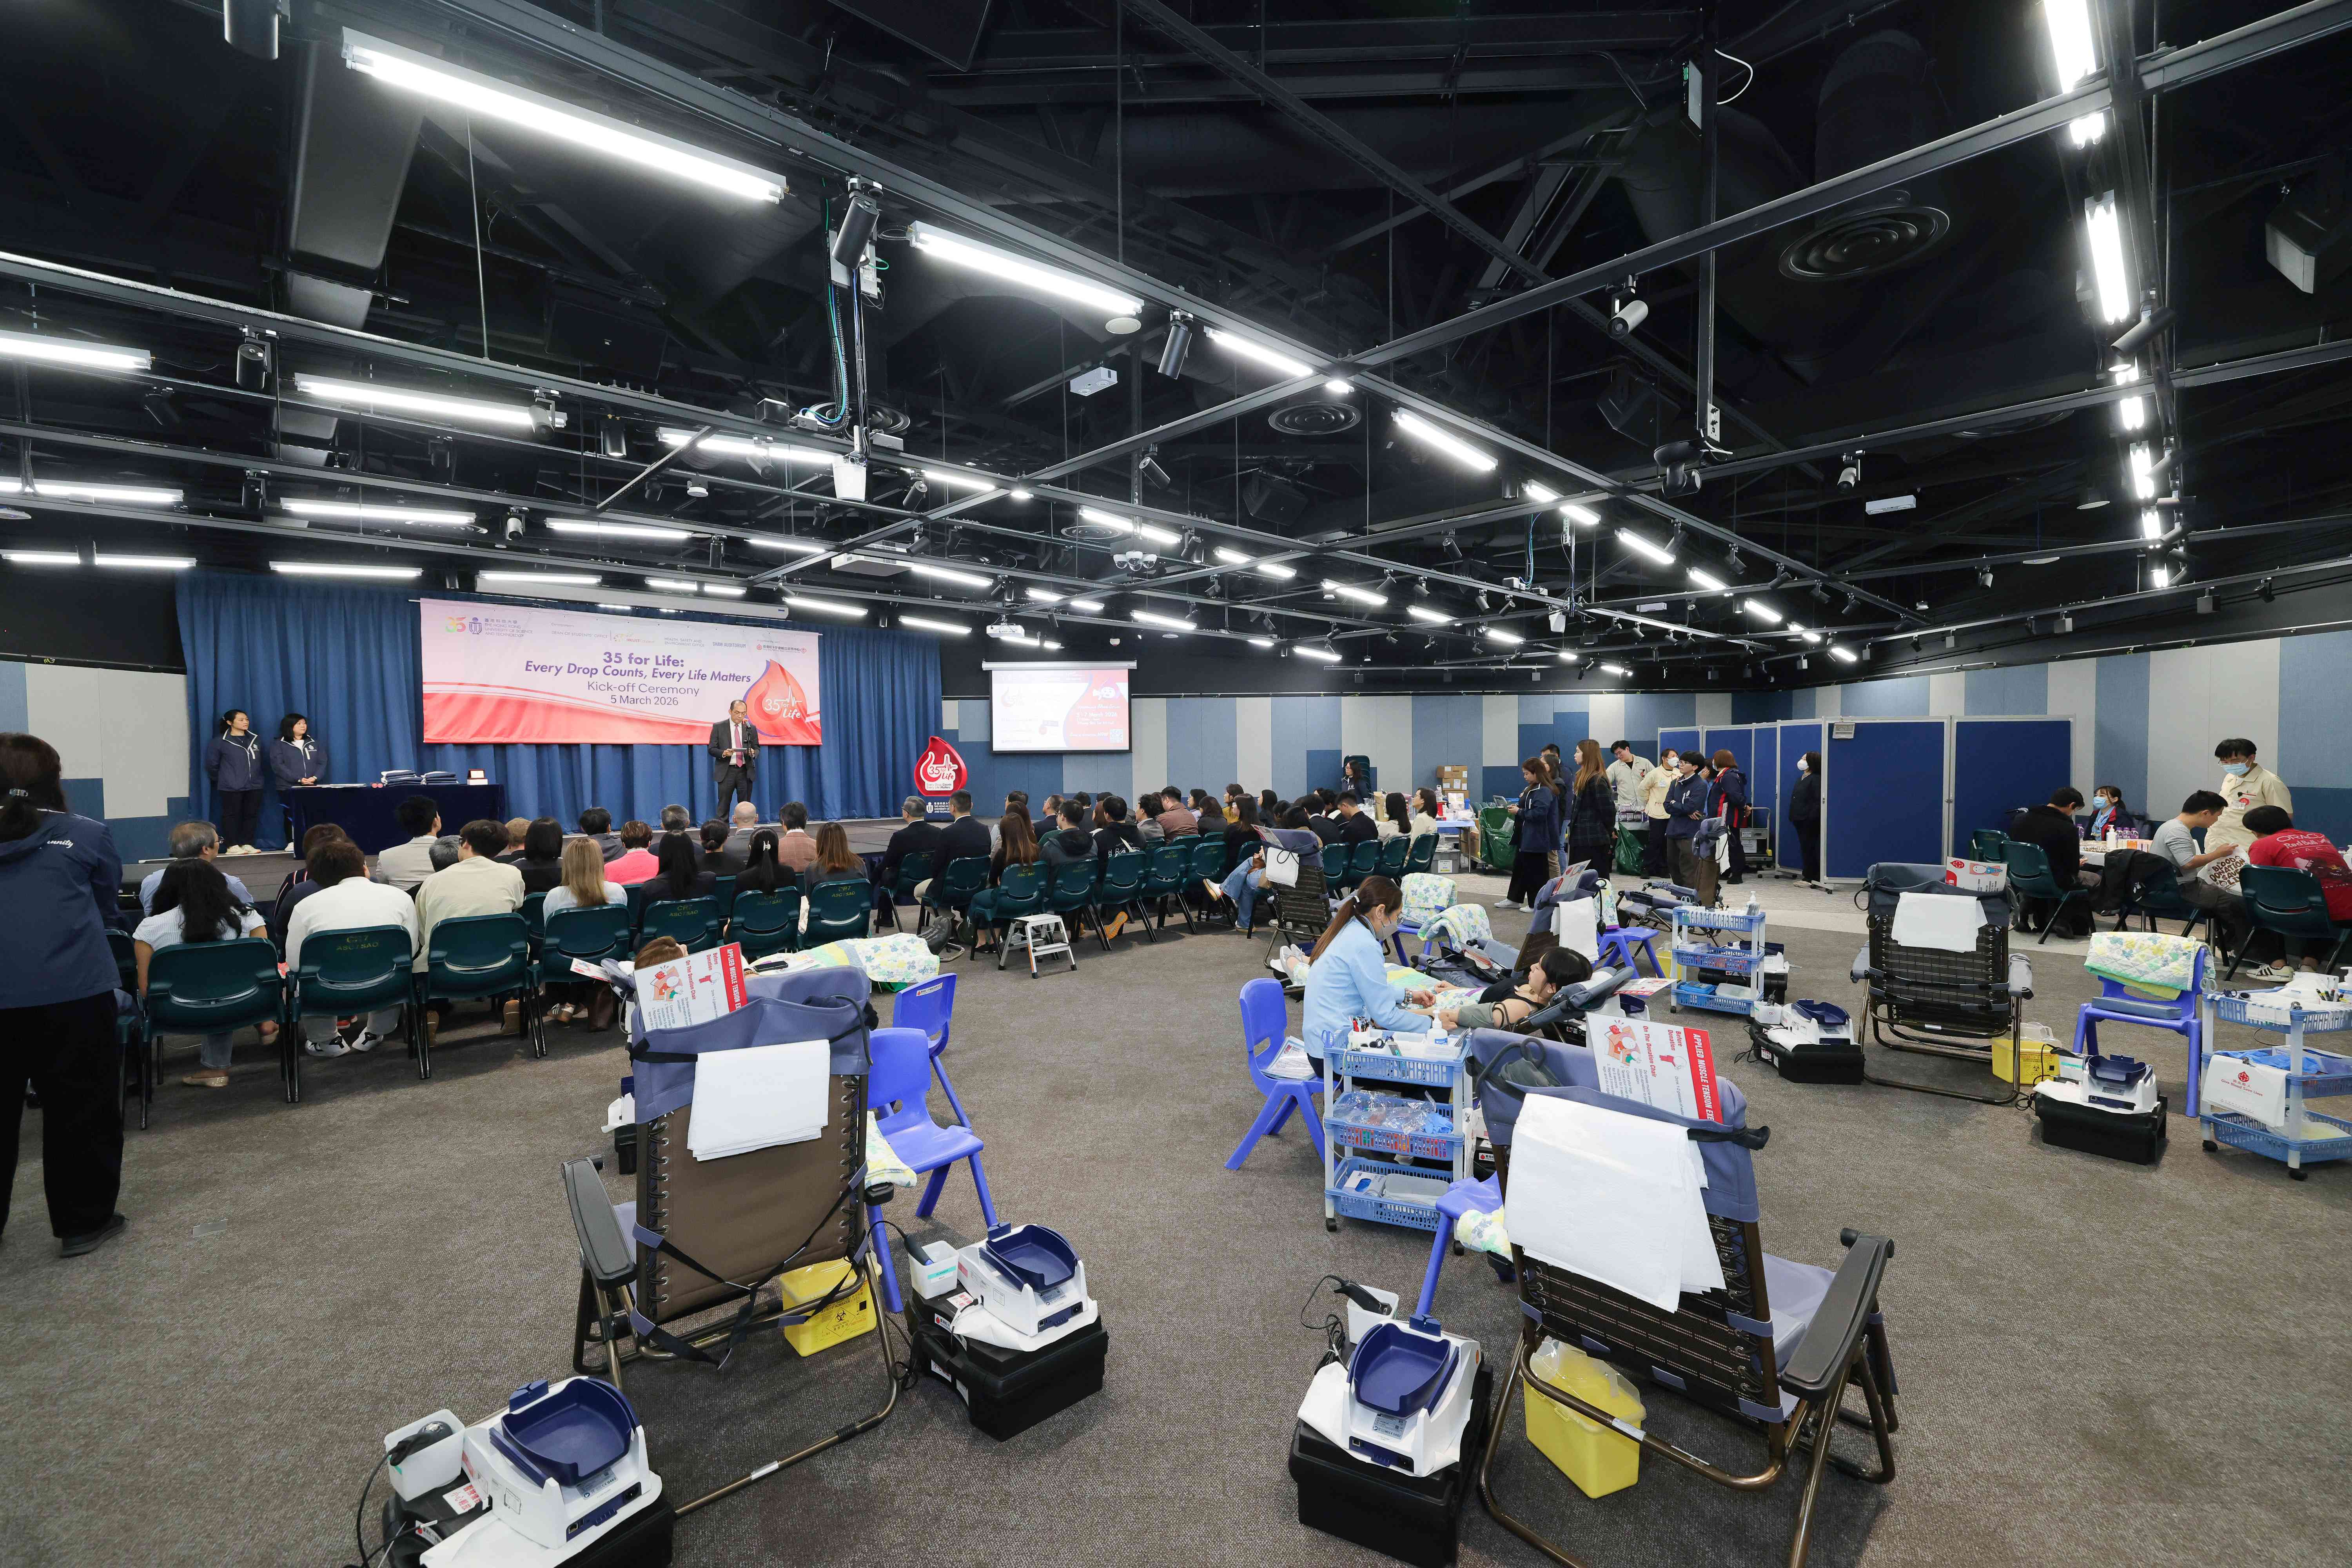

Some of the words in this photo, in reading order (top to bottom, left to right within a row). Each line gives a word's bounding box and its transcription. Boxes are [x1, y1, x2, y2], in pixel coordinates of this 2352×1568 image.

[603, 652, 622, 664] 35
[628, 653, 650, 665] for
[655, 655, 684, 667] Life:
[525, 661, 563, 676] Every
[567, 663, 598, 678] Drop
[603, 665, 647, 679] Counts,
[652, 668, 684, 682] Every
[688, 669, 707, 681] Life
[710, 671, 751, 682] Matters
[588, 681, 636, 692] Kick-off
[639, 683, 699, 697] Ceremony
[610, 695, 617, 704] 5
[620, 695, 651, 704] March
[654, 697, 678, 705] 2026
[764, 699, 780, 711] 35
[782, 708, 801, 720] Life
[2283, 840, 2301, 849] Red
[2209, 858, 2245, 882] DONATION
[2212, 858, 2236, 872] BLOOD
[729, 966, 737, 984] MUSCLE
[732, 984, 740, 1003] TENSION
[1693, 1033, 1704, 1058] APPLIED
[1698, 1059, 1708, 1083] MUSCLE
[1702, 1083, 1712, 1109] TENSION
